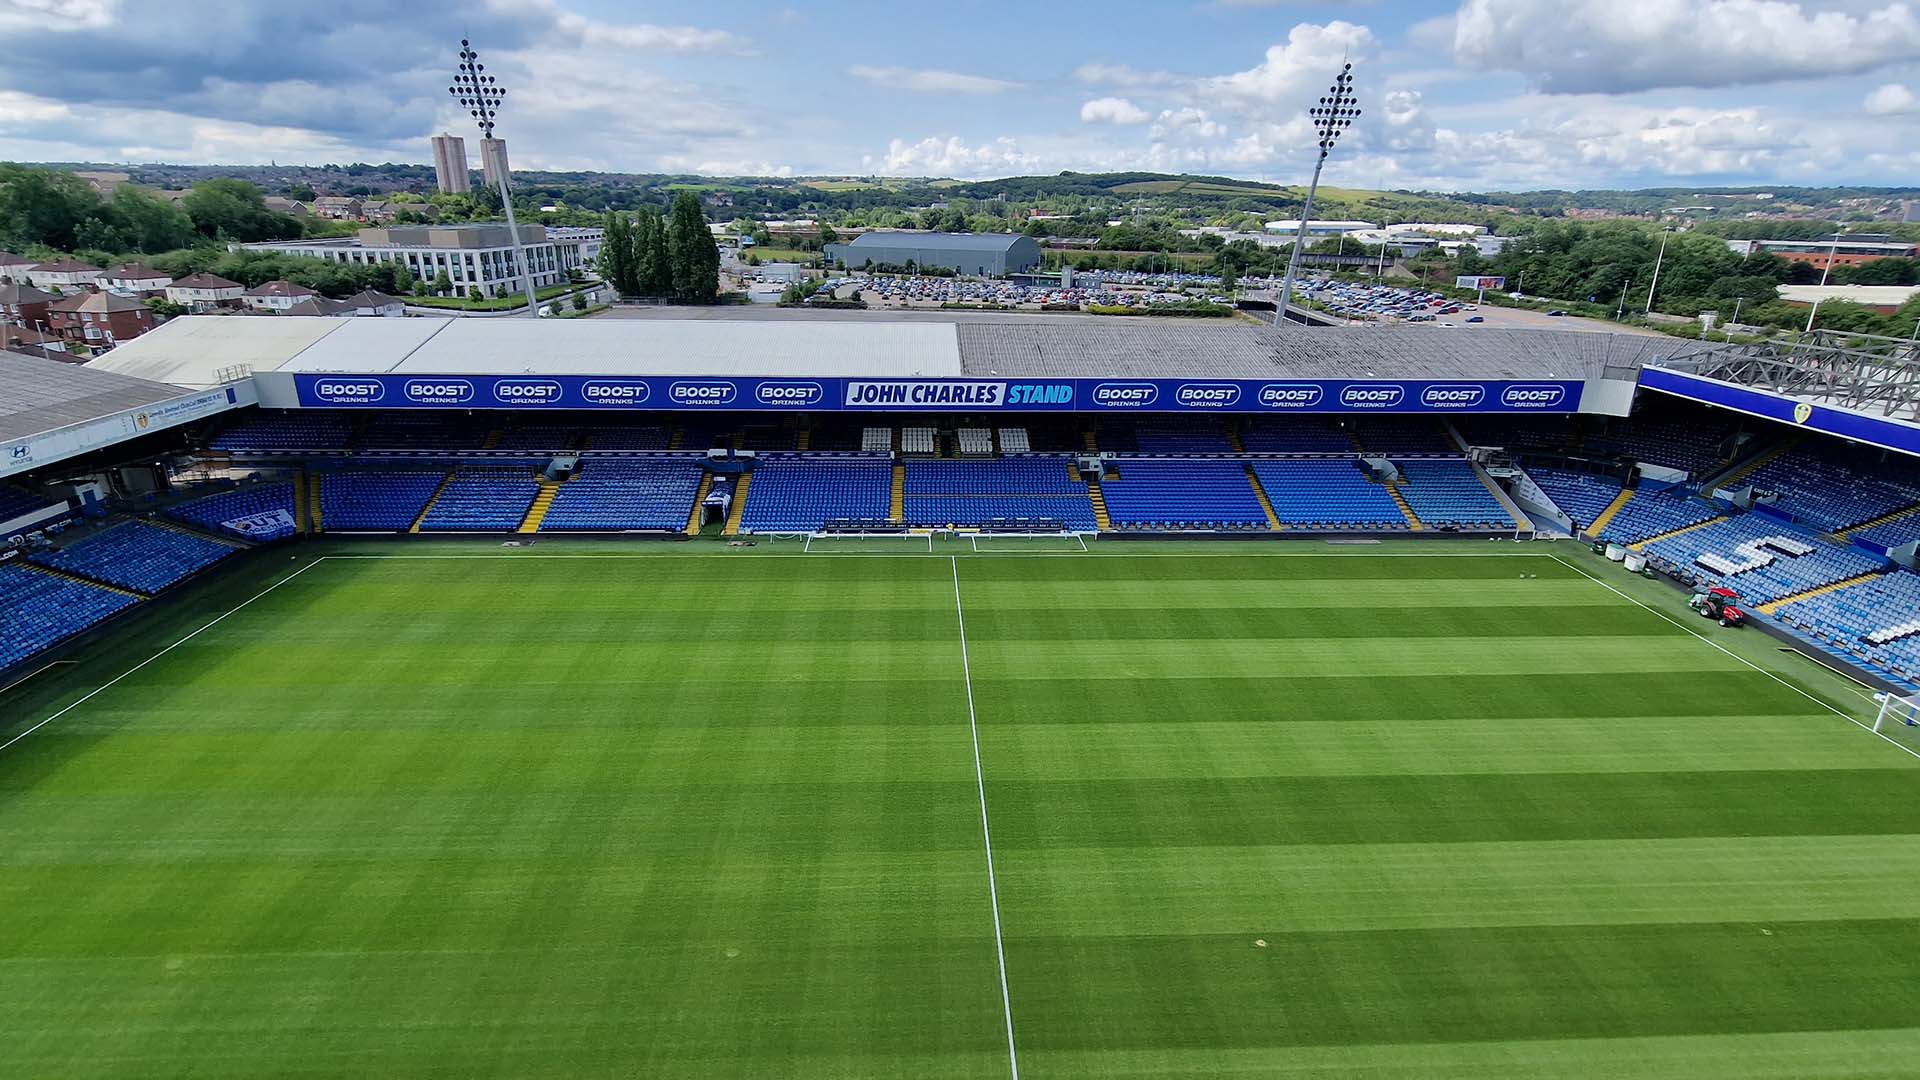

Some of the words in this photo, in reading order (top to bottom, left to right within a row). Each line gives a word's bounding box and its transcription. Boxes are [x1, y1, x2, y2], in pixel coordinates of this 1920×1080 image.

[320, 384, 379, 395] BOOST
[410, 385, 468, 396] BOOST
[499, 385, 557, 396] BOOST
[587, 386, 645, 397] BOOST
[674, 387, 731, 398] BOOST
[761, 387, 818, 398] BOOST
[852, 385, 908, 403] JOHN
[911, 385, 998, 403] CHARLES
[1008, 385, 1073, 404] STAND
[1098, 389, 1153, 399] BOOST
[1181, 389, 1236, 399] BOOST
[1263, 390, 1318, 400] BOOST
[1344, 390, 1400, 400] BOOST
[1425, 390, 1480, 400] BOOST
[1506, 390, 1561, 400] BOOST
